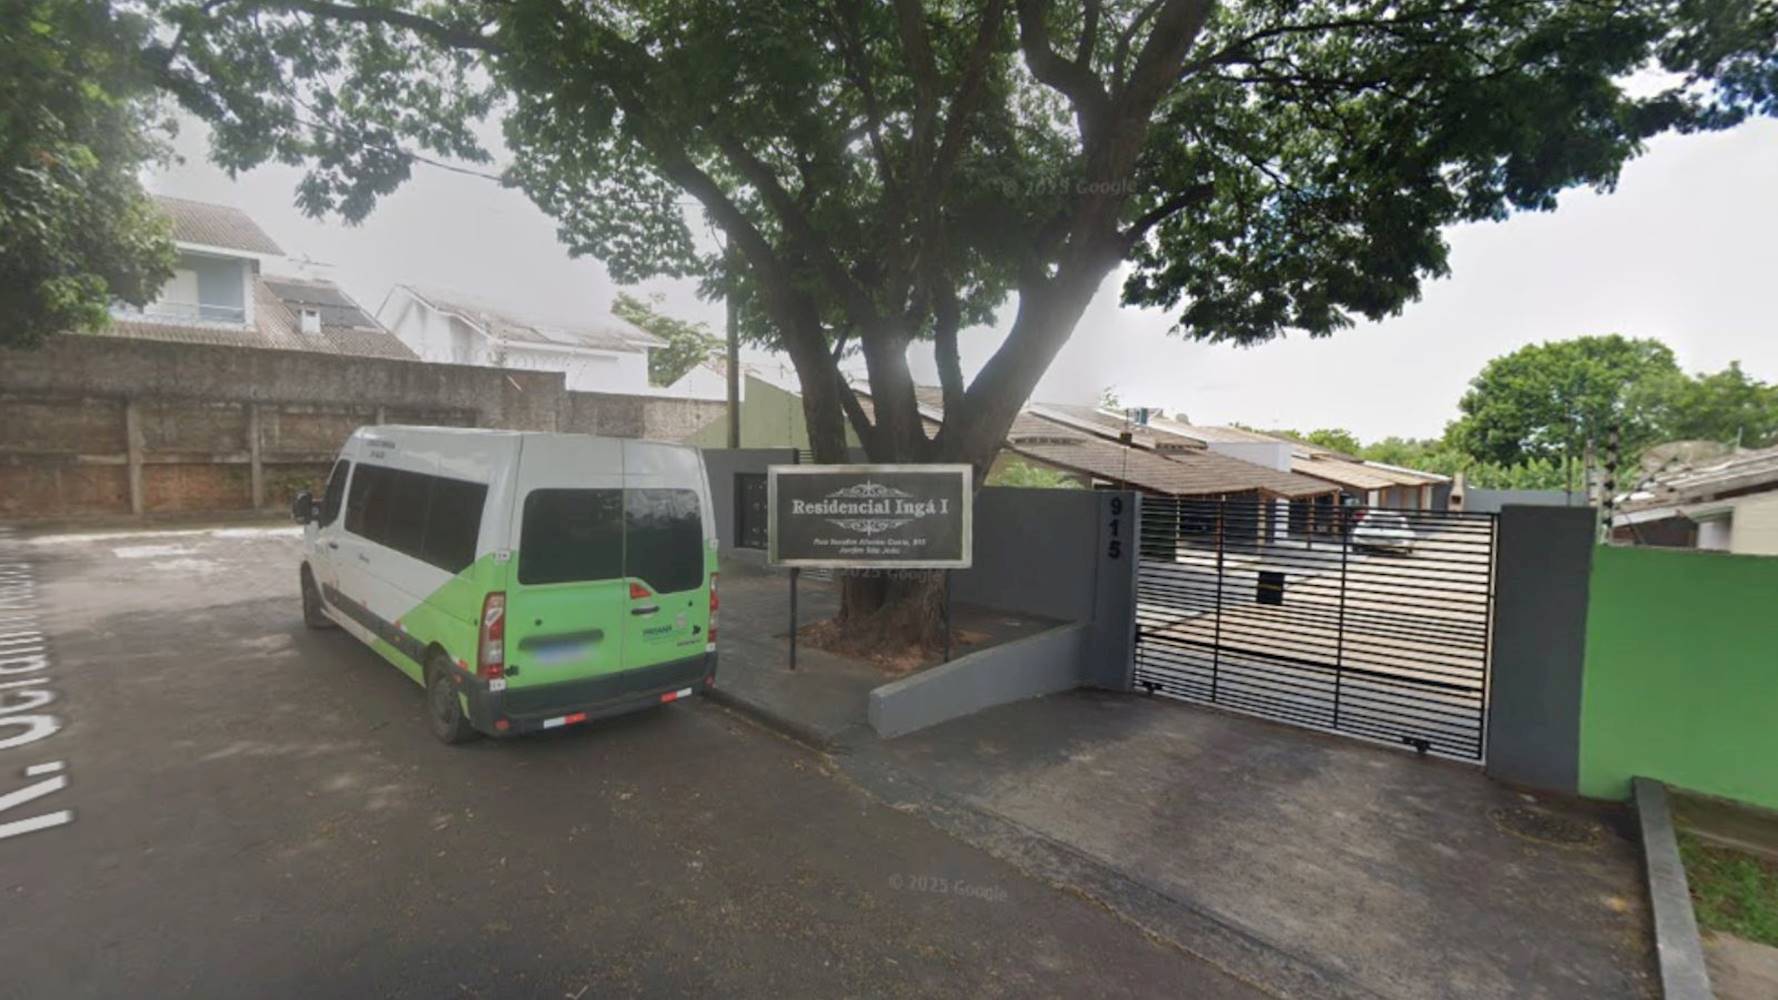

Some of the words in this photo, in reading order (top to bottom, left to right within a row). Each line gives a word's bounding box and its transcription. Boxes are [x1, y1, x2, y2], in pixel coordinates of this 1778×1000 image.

[791, 499, 890, 515] Residencial
[895, 499, 936, 518] Ingá
[939, 499, 949, 515] I
[1108, 496, 1122, 559] 915
